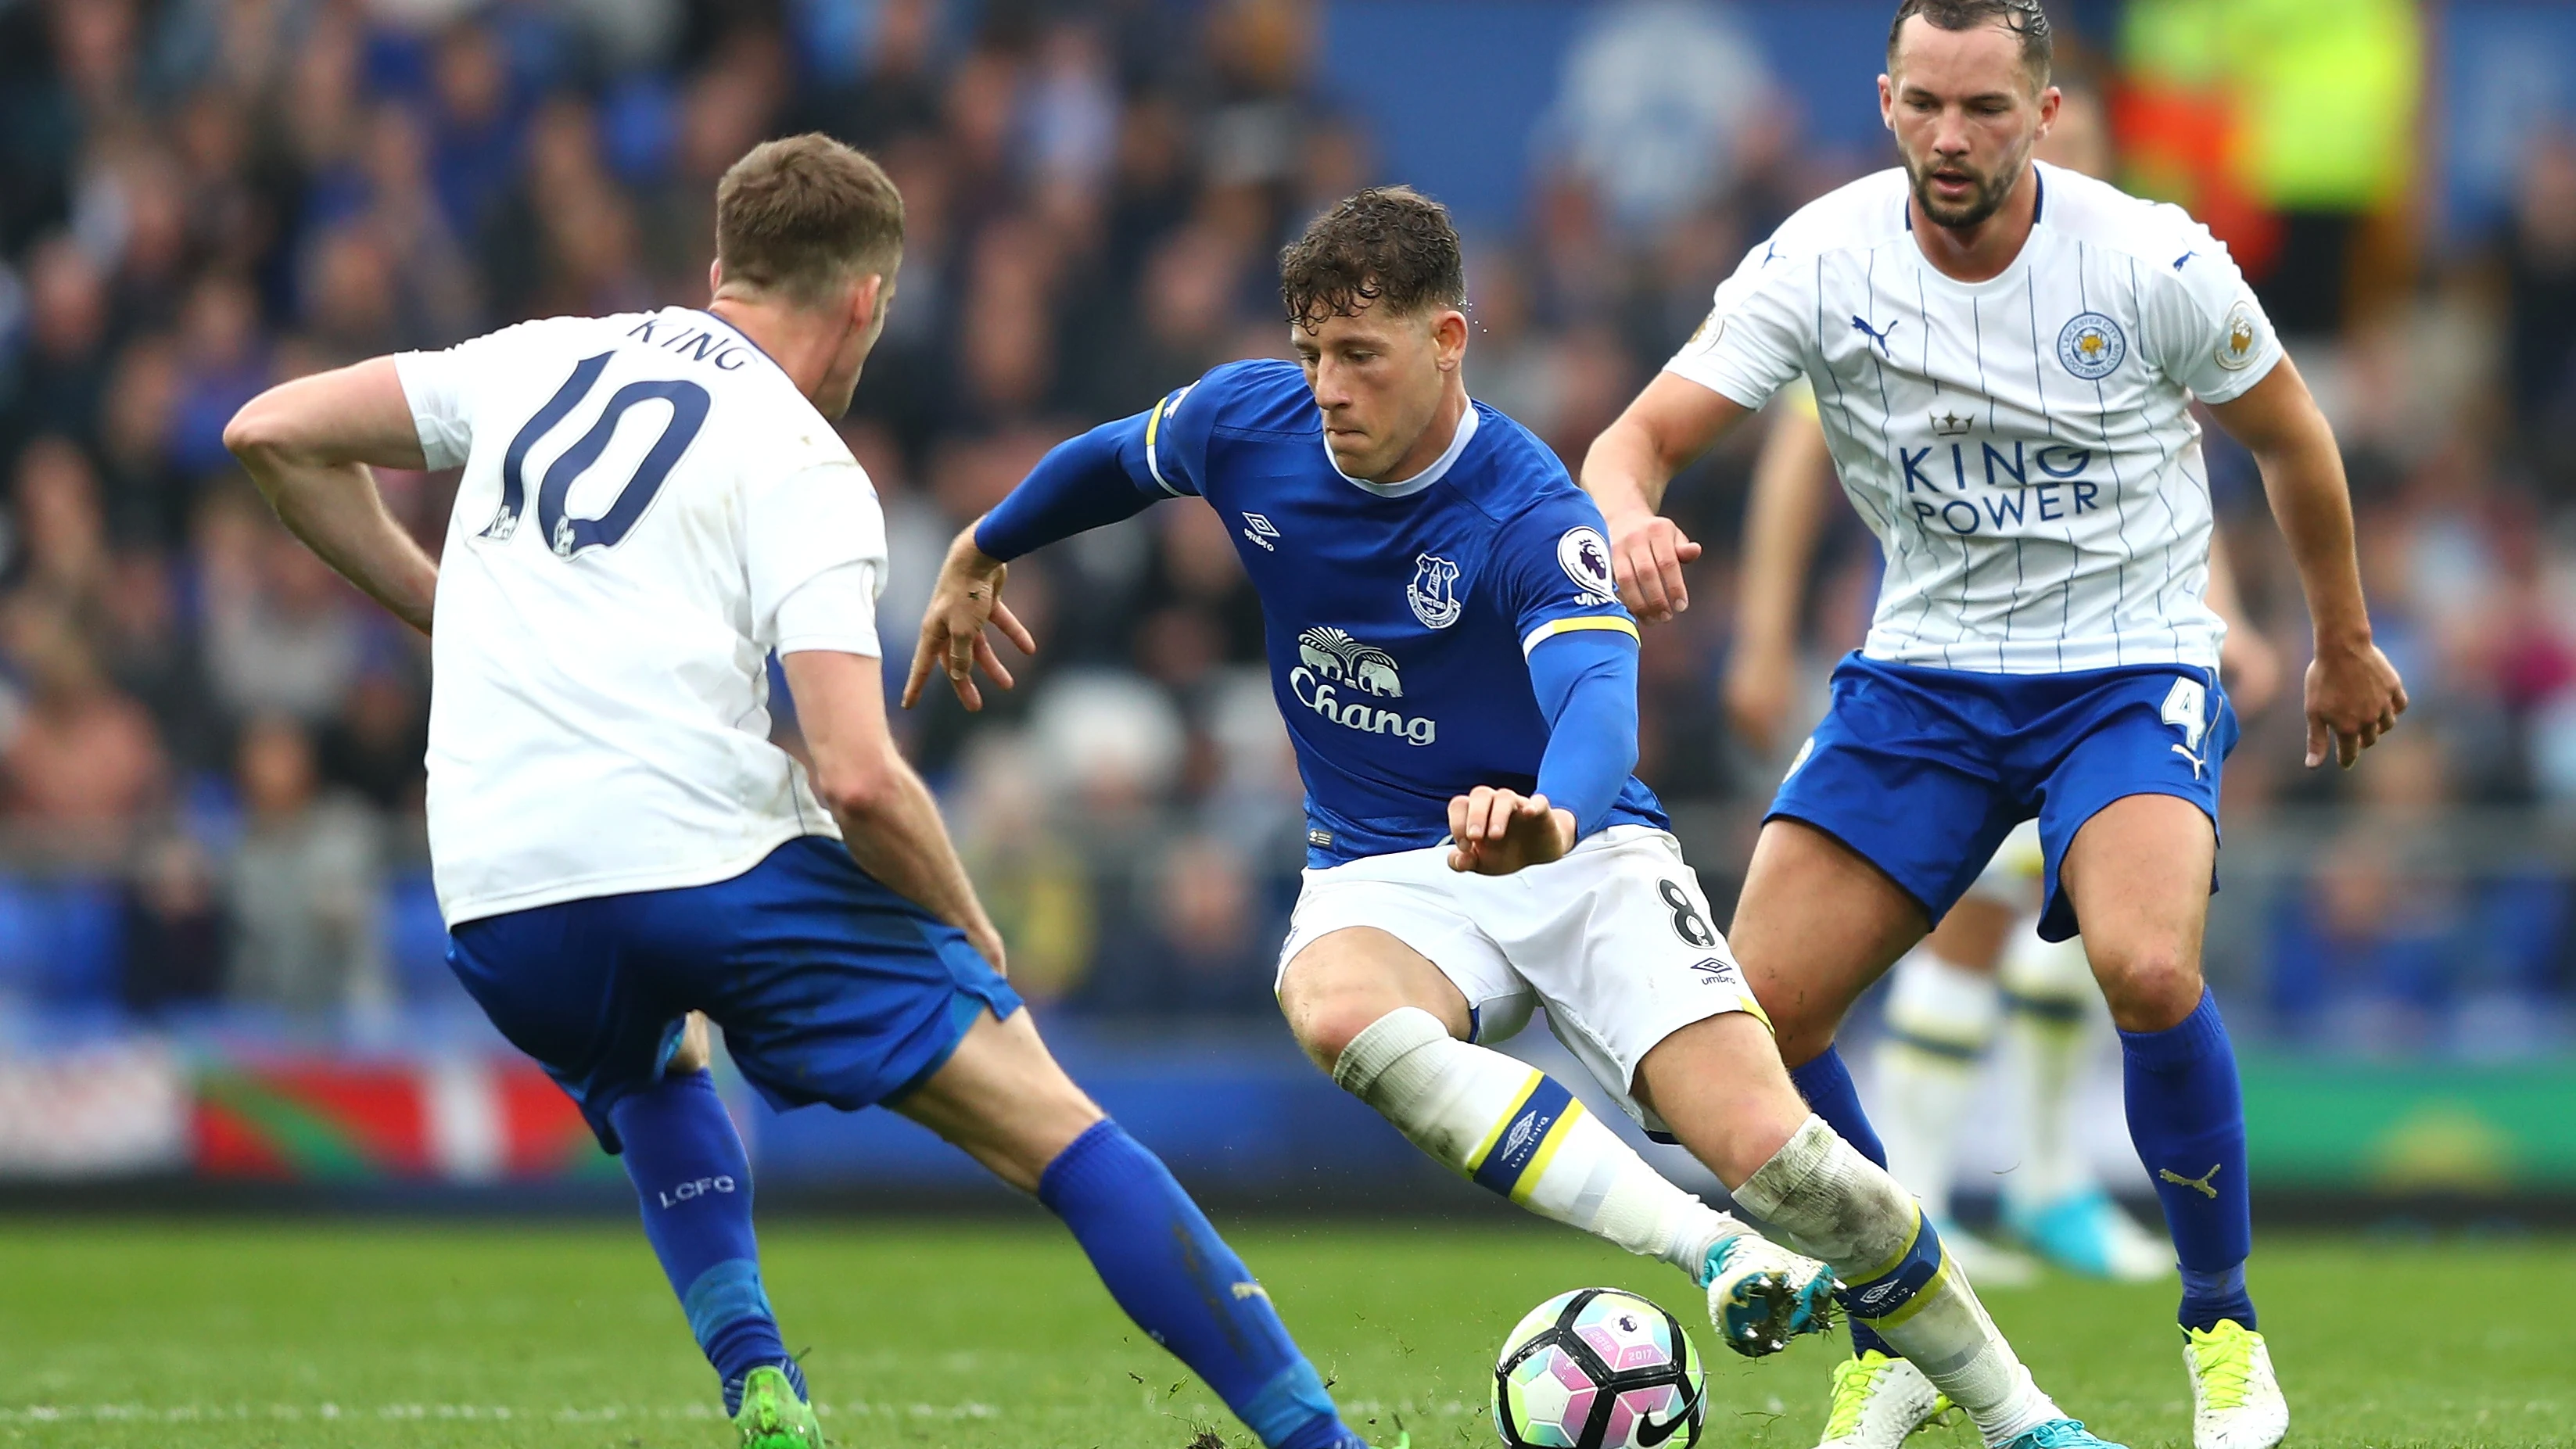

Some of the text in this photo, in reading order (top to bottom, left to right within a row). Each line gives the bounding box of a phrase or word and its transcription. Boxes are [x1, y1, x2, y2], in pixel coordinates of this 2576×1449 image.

[627, 319, 746, 371] KING
[475, 349, 713, 557] 10
[1900, 441, 2092, 493] KING
[1914, 482, 2099, 535] POWER
[1244, 528, 1274, 551] umbro
[1290, 666, 1436, 746] Chang
[2161, 676, 2206, 751] 4
[1659, 879, 1715, 947] 8
[1701, 974, 1736, 985] umbro
[658, 1175, 735, 1210] LCFC
[1628, 1349, 1652, 1362] 2017
